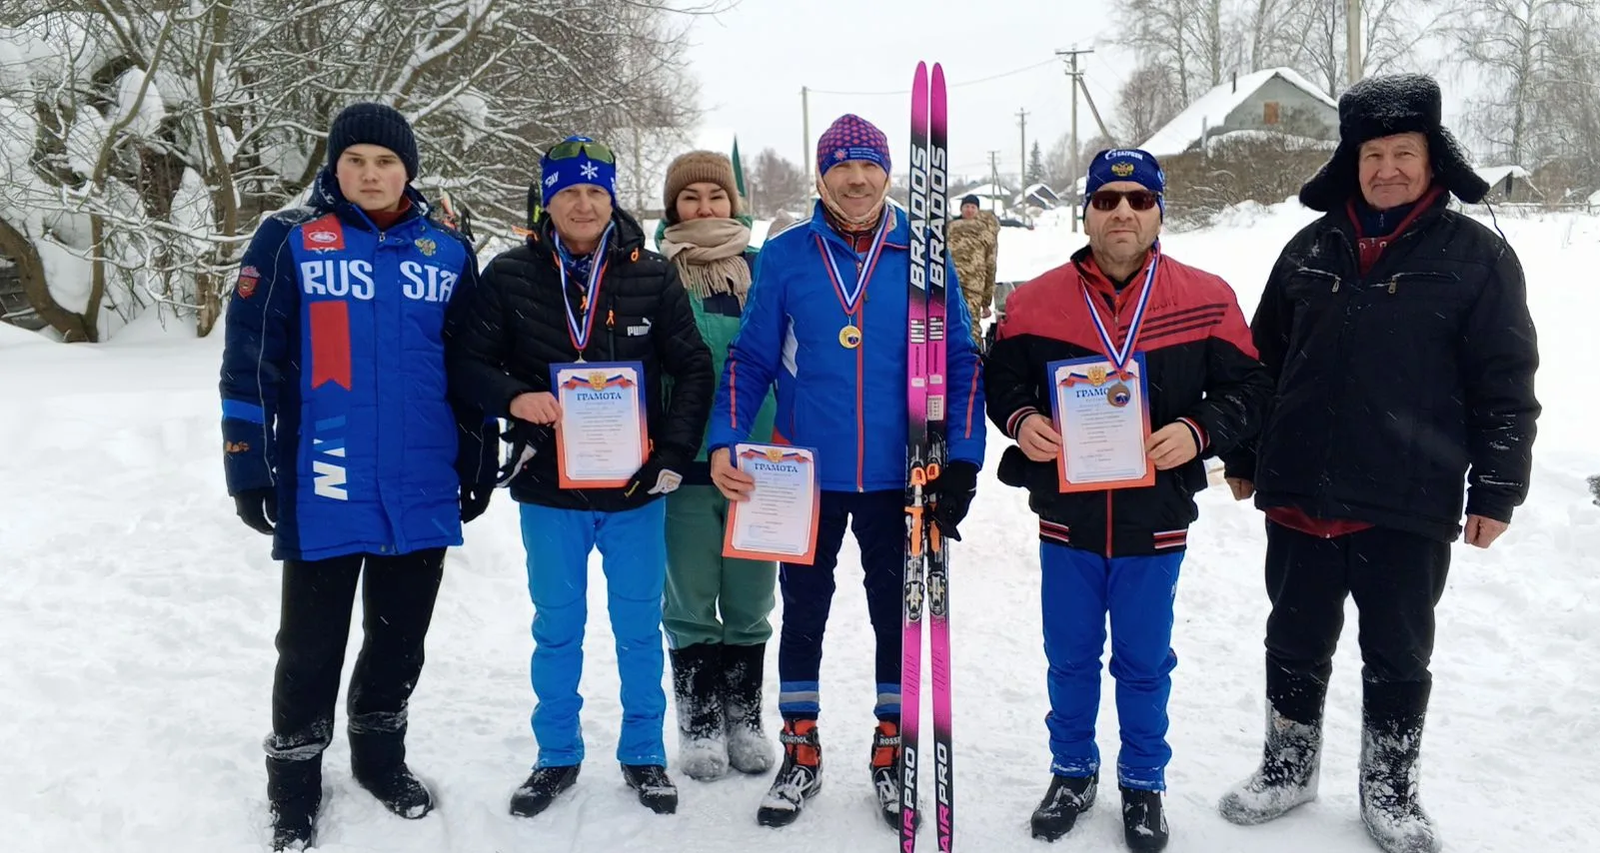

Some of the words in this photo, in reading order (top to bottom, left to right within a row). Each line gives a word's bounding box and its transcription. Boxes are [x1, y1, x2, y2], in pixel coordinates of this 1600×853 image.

[910, 143, 927, 290] BRADOS
[930, 145, 946, 288] BRADOS
[577, 391, 622, 401] ГРАМОТА
[1076, 387, 1108, 399] ГРАМО
[755, 462, 799, 474] ГРАМОТА
